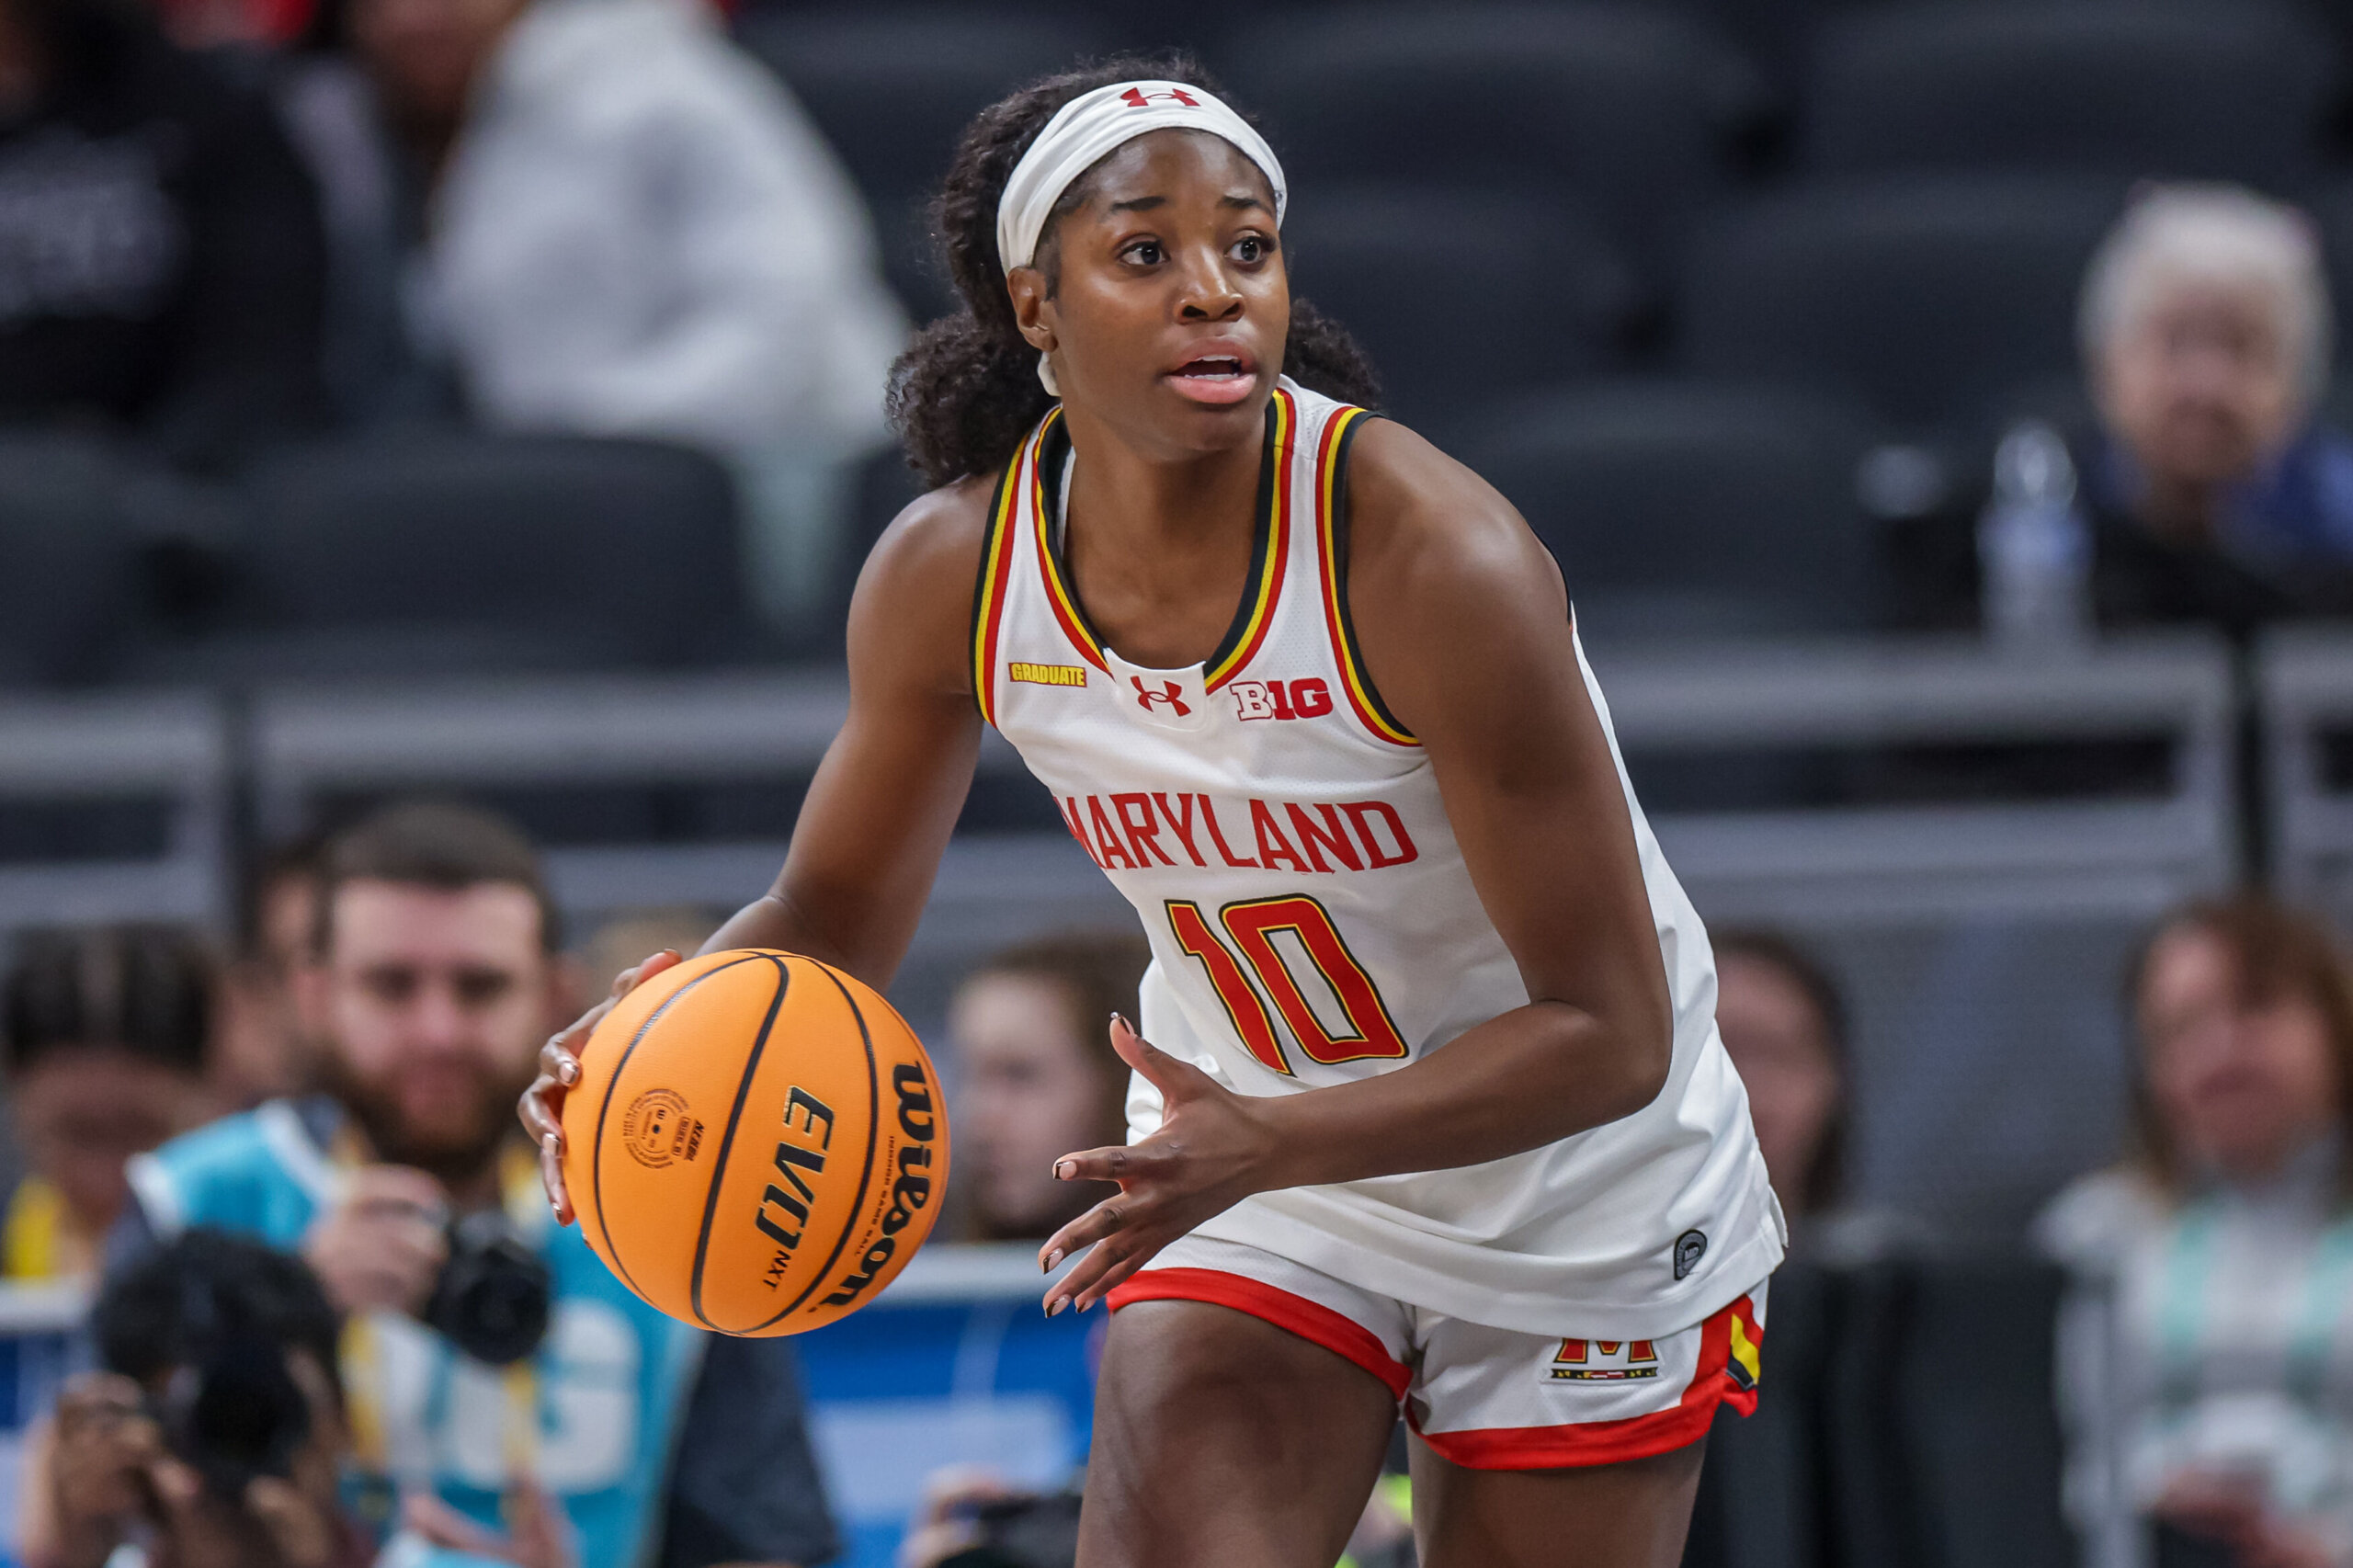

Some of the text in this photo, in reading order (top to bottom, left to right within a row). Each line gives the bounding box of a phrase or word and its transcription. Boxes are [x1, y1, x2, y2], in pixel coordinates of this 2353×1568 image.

[1011, 663, 1085, 687] GRADUATE
[1164, 893, 1409, 1077] 10
[755, 1085, 835, 1291] EVO NXT
